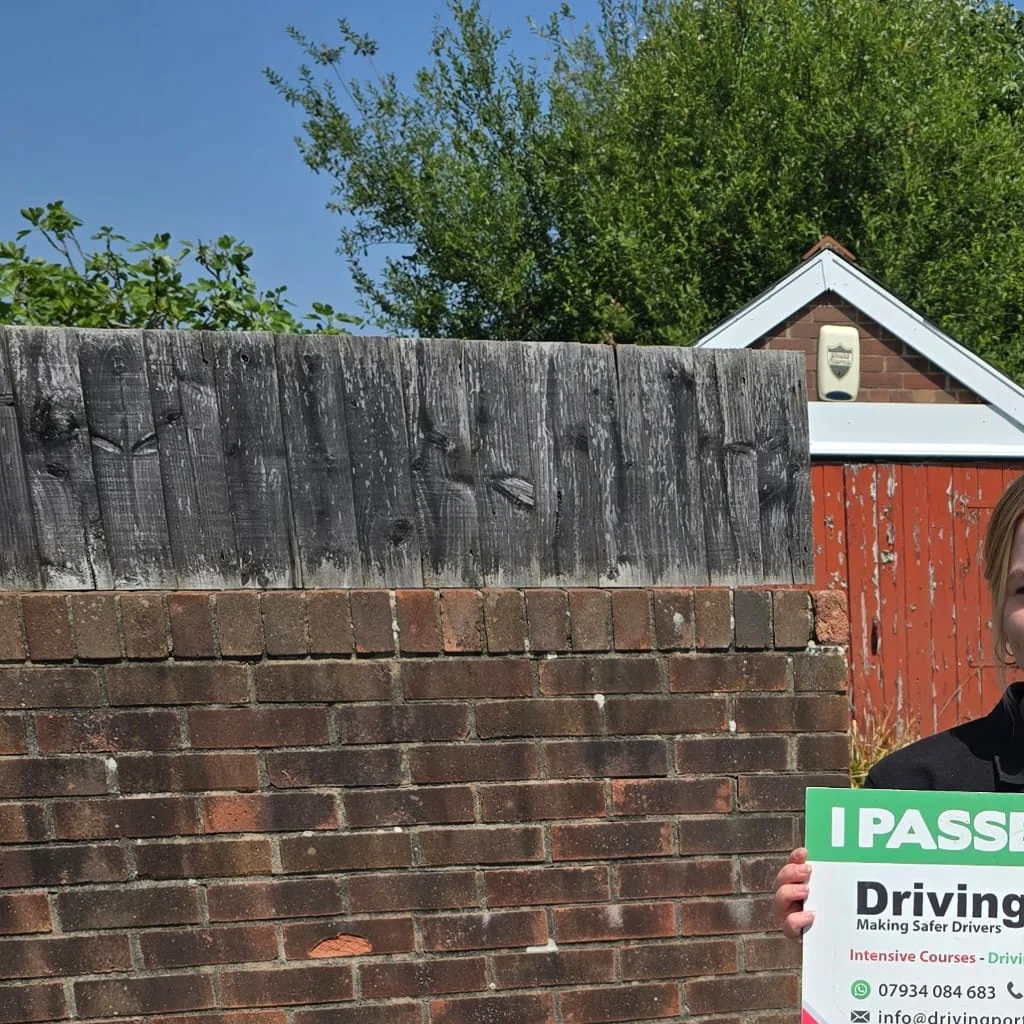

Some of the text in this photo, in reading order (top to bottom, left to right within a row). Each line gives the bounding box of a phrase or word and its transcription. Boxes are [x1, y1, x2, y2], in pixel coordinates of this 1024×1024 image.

[831, 806, 845, 848] I
[856, 918, 1002, 934] Making Safer Drivers
[849, 948, 916, 962] Intensive
[919, 950, 976, 964] Courses
[878, 983, 996, 1000] 07934 084 683
